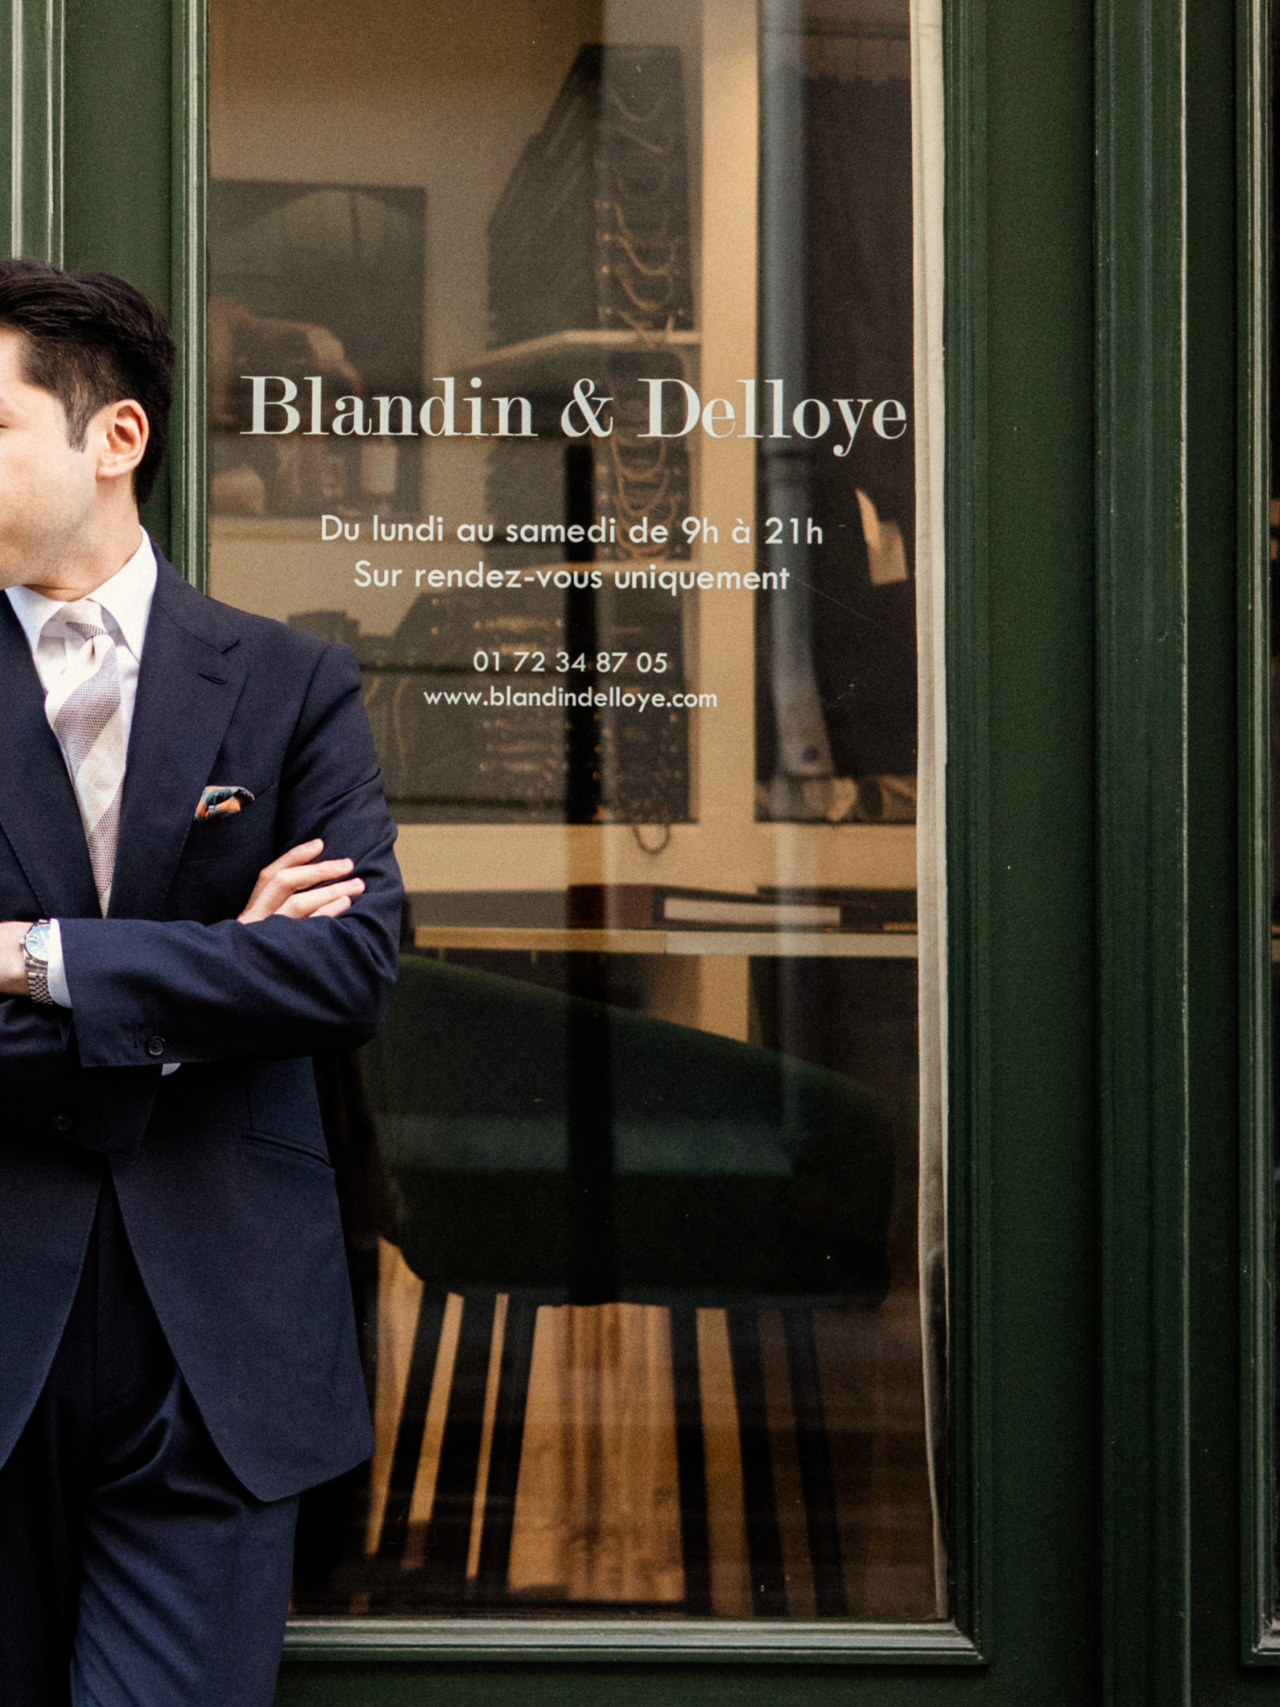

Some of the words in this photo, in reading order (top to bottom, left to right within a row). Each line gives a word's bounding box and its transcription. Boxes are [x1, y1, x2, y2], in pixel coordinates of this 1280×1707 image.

[239, 375, 539, 437] Blandin
[560, 378, 614, 438] &
[638, 378, 908, 457] Delloye
[320, 514, 360, 542] Du
[372, 515, 445, 542] lundi
[457, 523, 494, 542] au
[505, 516, 616, 543] samedi
[629, 516, 669, 543] de
[681, 516, 718, 544] 9h
[731, 516, 751, 544] à
[765, 517, 823, 545] 21h
[353, 559, 402, 587] Sur
[414, 561, 602, 589] rendez-vous
[614, 564, 790, 595] uniquement
[473, 650, 502, 672] 01
[513, 650, 546, 672] 72
[555, 651, 586, 672] 34
[595, 651, 628, 672] 87
[636, 652, 667, 673] 05
[423, 685, 717, 712] www.blandindelloye.com
